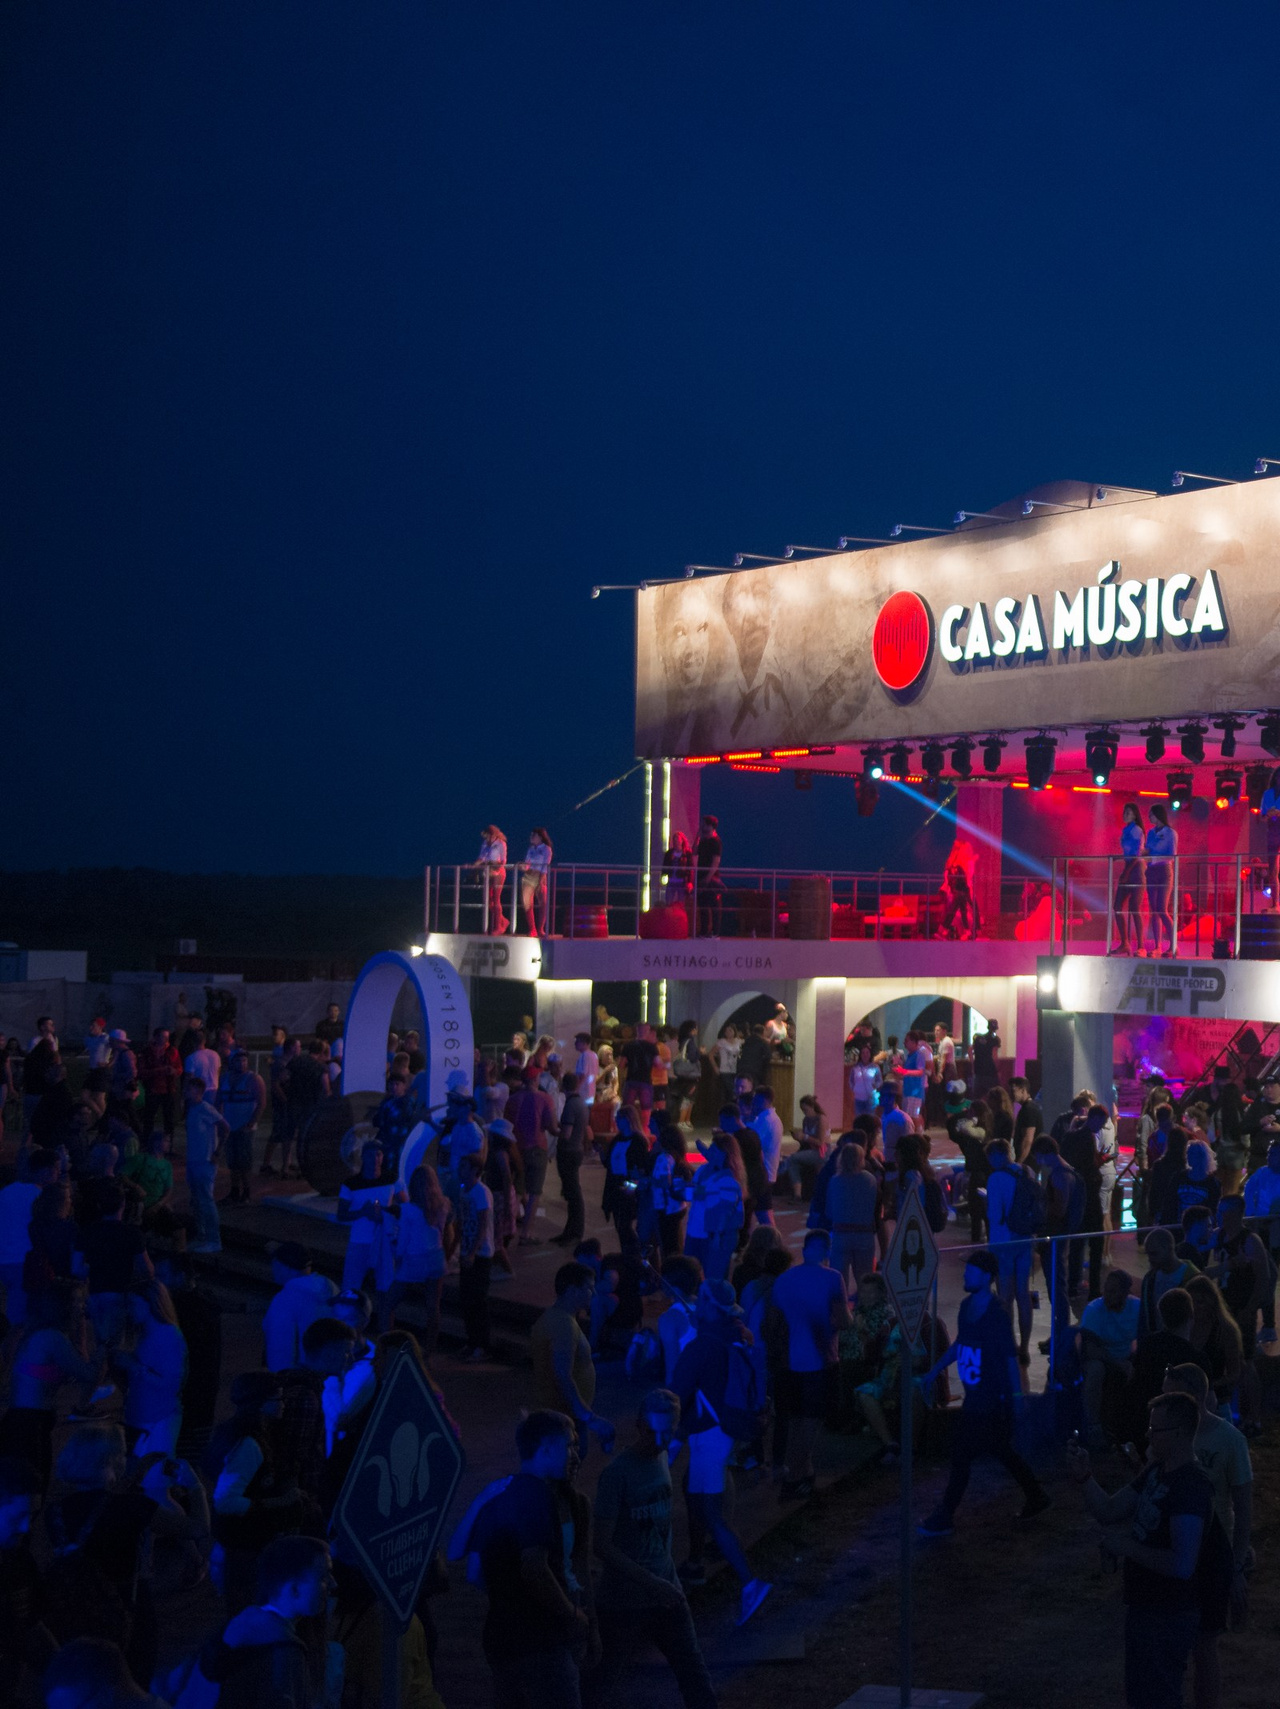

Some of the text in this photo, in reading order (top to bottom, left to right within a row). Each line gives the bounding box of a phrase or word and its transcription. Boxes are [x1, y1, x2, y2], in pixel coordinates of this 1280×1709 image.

[940, 560, 1225, 663] CASA MÚSICA
[458, 941, 510, 976] AFP
[643, 954, 718, 968] SANTIAGO
[735, 956, 772, 969] CUBA
[1117, 963, 1226, 1015] AFP
[1151, 977, 1181, 988] FUTURE
[1184, 978, 1214, 990] PEOPLE
[441, 1004, 461, 1068] 1862
[380, 1521, 430, 1561] ГЛАВНАЯ
[386, 1546, 424, 1579] СЦЕНА
